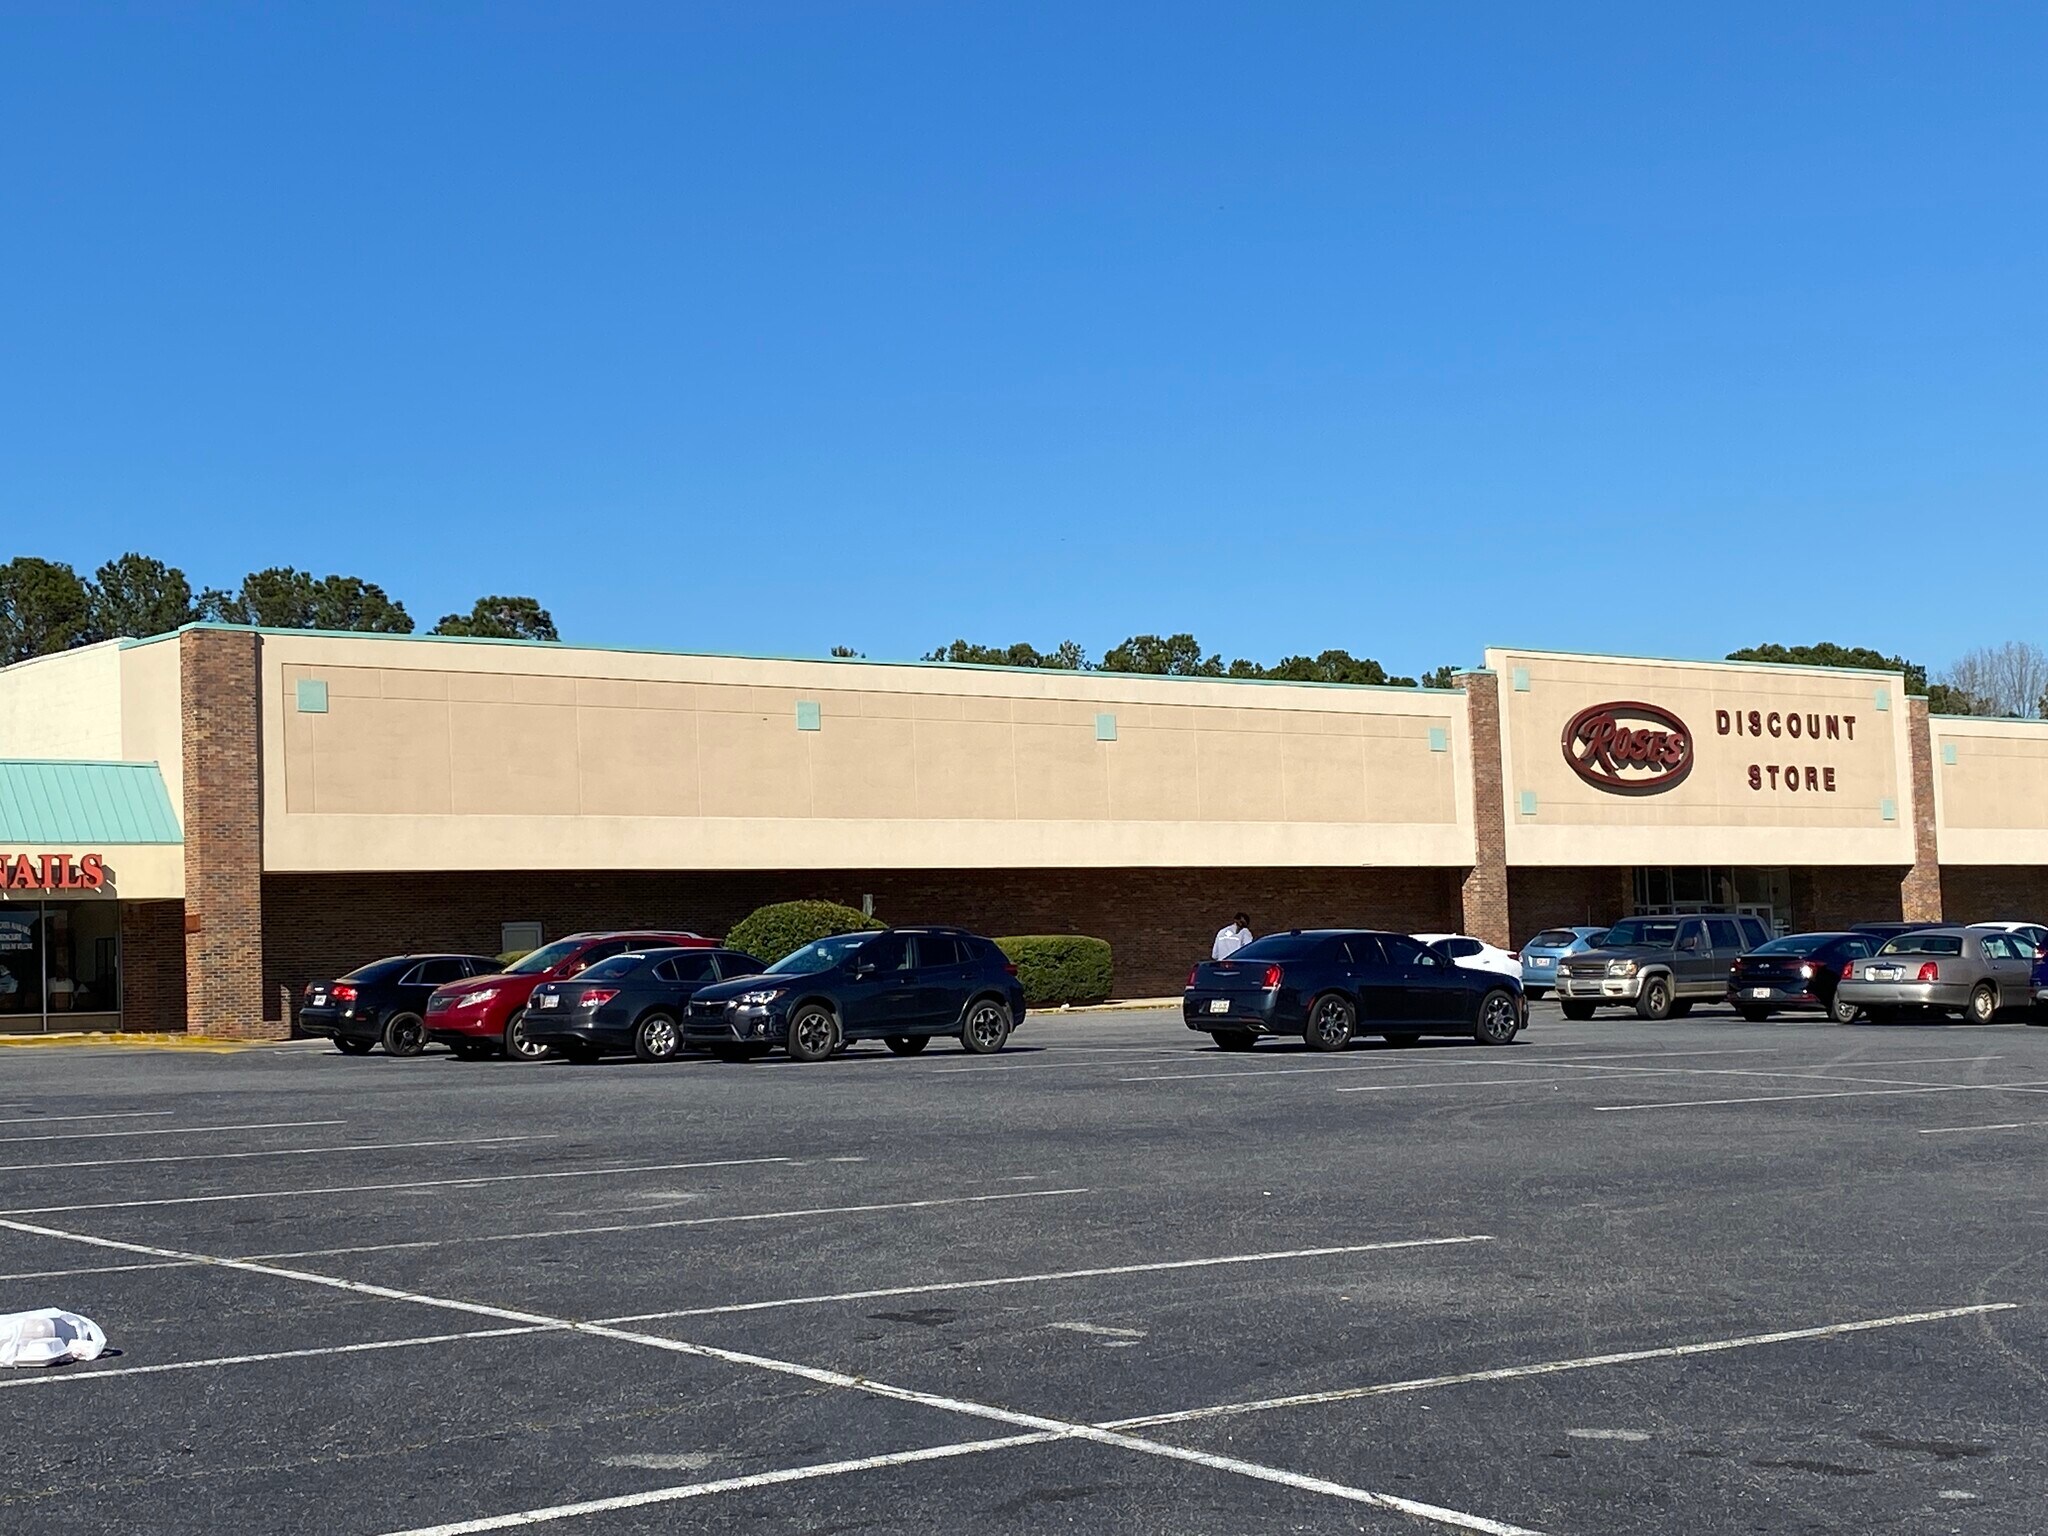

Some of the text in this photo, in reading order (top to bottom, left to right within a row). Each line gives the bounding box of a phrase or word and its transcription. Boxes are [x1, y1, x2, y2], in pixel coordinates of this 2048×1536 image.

[1716, 709, 1856, 740] DISCOUNT
[1578, 713, 1685, 772] ROSES
[1747, 764, 1836, 791] STORE
